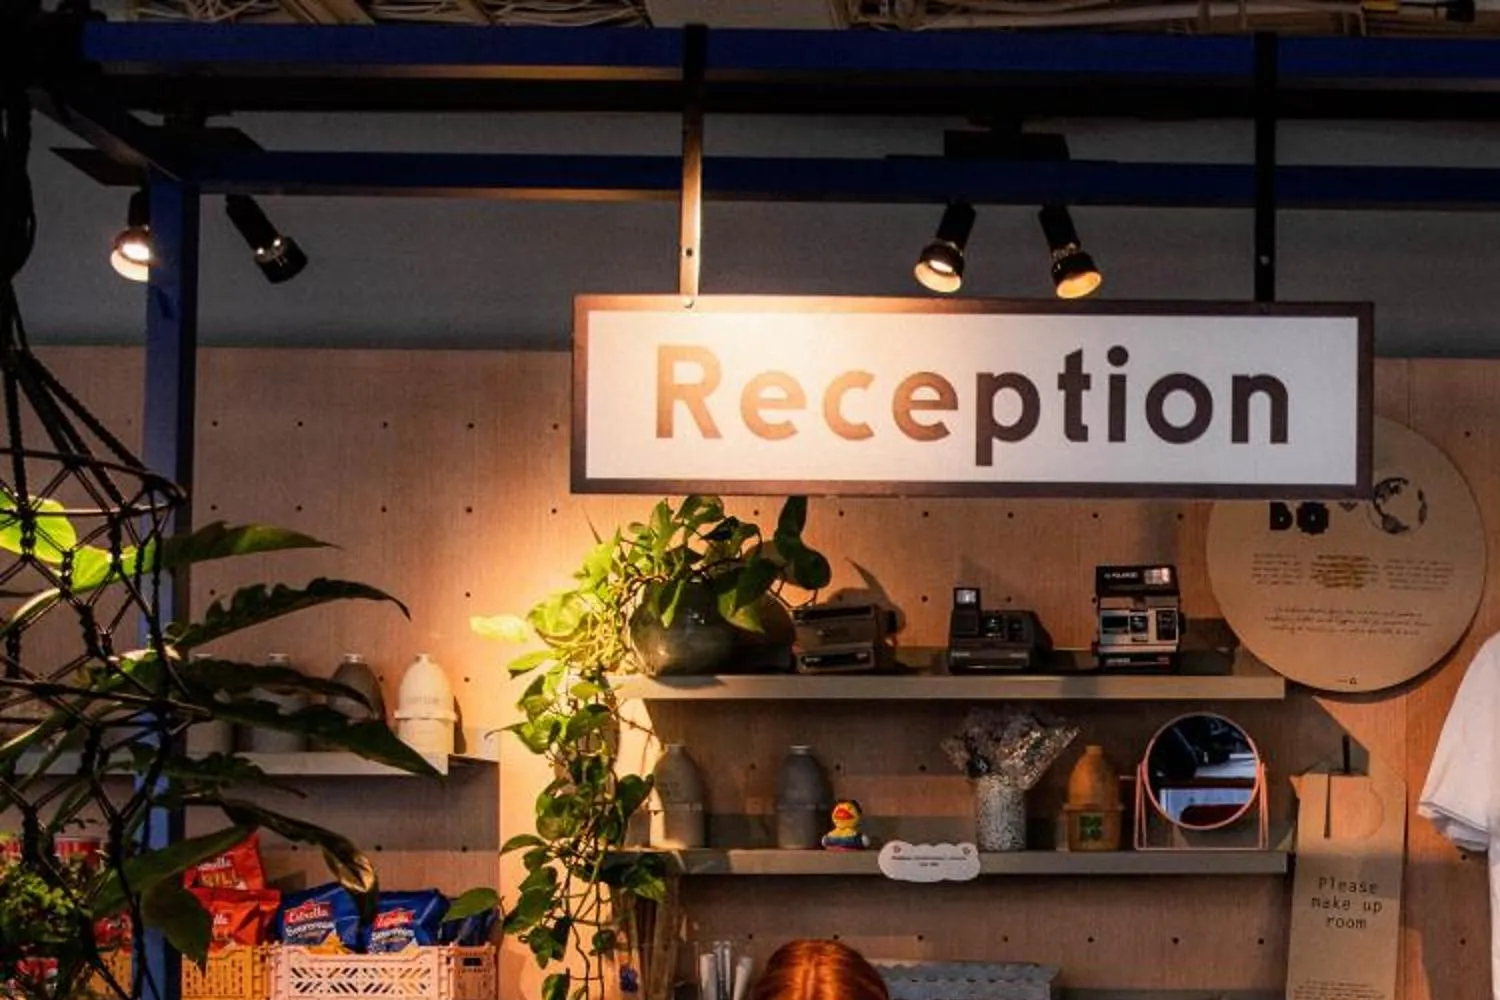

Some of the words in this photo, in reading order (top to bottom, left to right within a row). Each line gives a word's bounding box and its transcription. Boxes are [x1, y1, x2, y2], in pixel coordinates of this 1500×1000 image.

[655, 344, 1290, 467] Reception
[1318, 876, 1379, 894] Please
[1311, 896, 1351, 911] make
[1363, 900, 1383, 914] up
[1325, 915, 1367, 929] room
